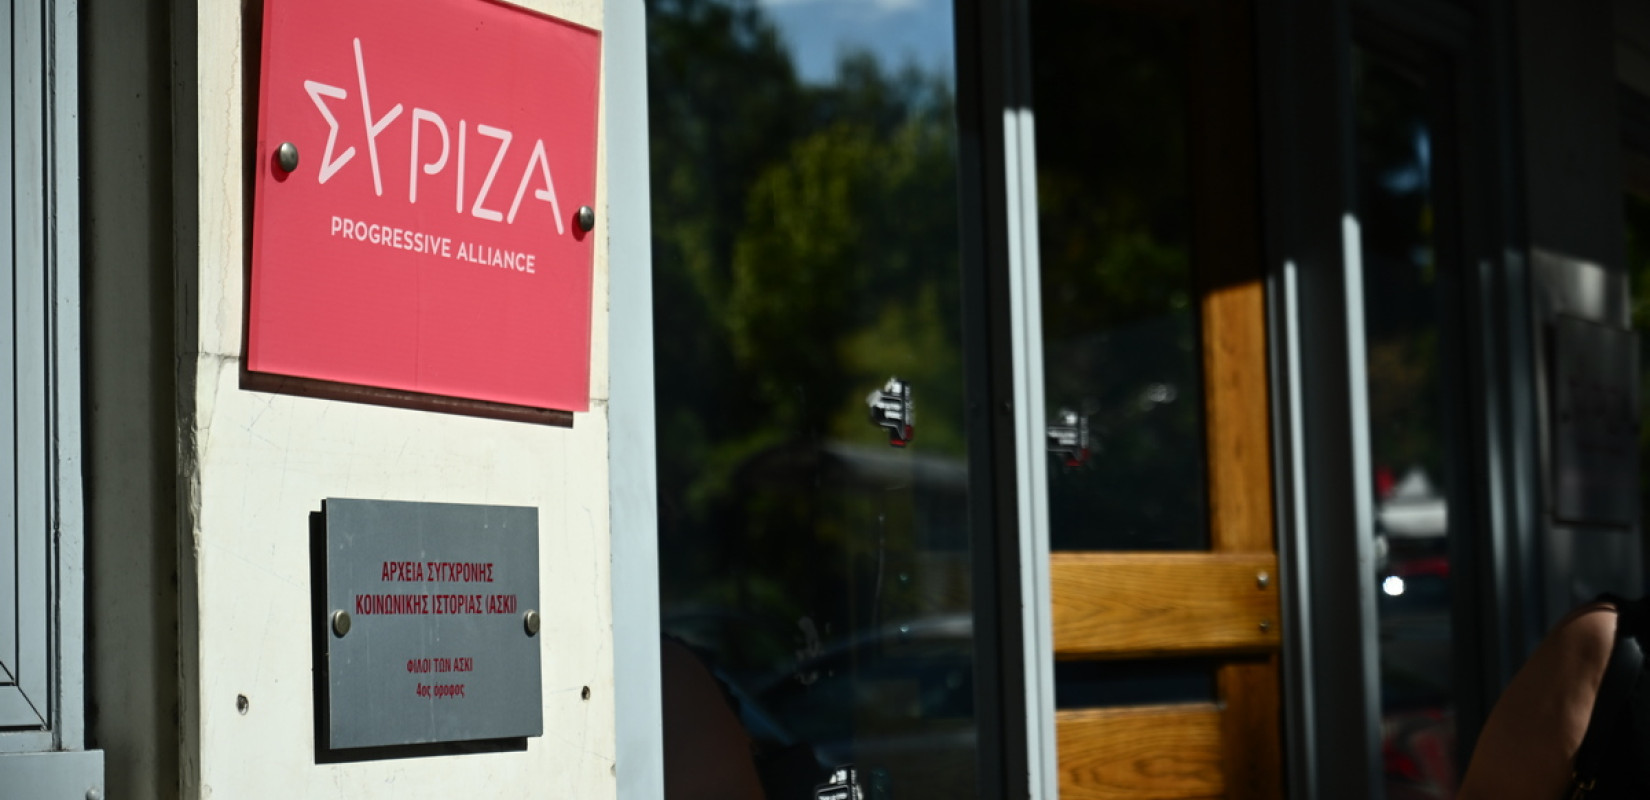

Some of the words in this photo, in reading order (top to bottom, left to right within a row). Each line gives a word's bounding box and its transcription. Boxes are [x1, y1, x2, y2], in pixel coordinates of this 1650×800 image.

[331, 216, 451, 258] PROGRESSIVE
[456, 242, 536, 274] ALLIANCE
[381, 561, 424, 582] ΑΡΧΕΙΑ
[427, 562, 494, 582] ΣΥΓΧΡΟΝΗΣ
[355, 594, 429, 615] ΚΟΙΝΩΝΙΚΗΣ
[432, 595, 483, 614] ΙΣΤΟΡΙΑΣ
[485, 594, 517, 614] (ΑΣΚΙ)
[406, 658, 431, 674] ΦΙΛΟΙ
[433, 658, 451, 673] ΤΩΝ
[453, 657, 473, 672] ΑΣΚΙ
[416, 682, 431, 699] 4ος
[433, 682, 465, 698] όροφος
